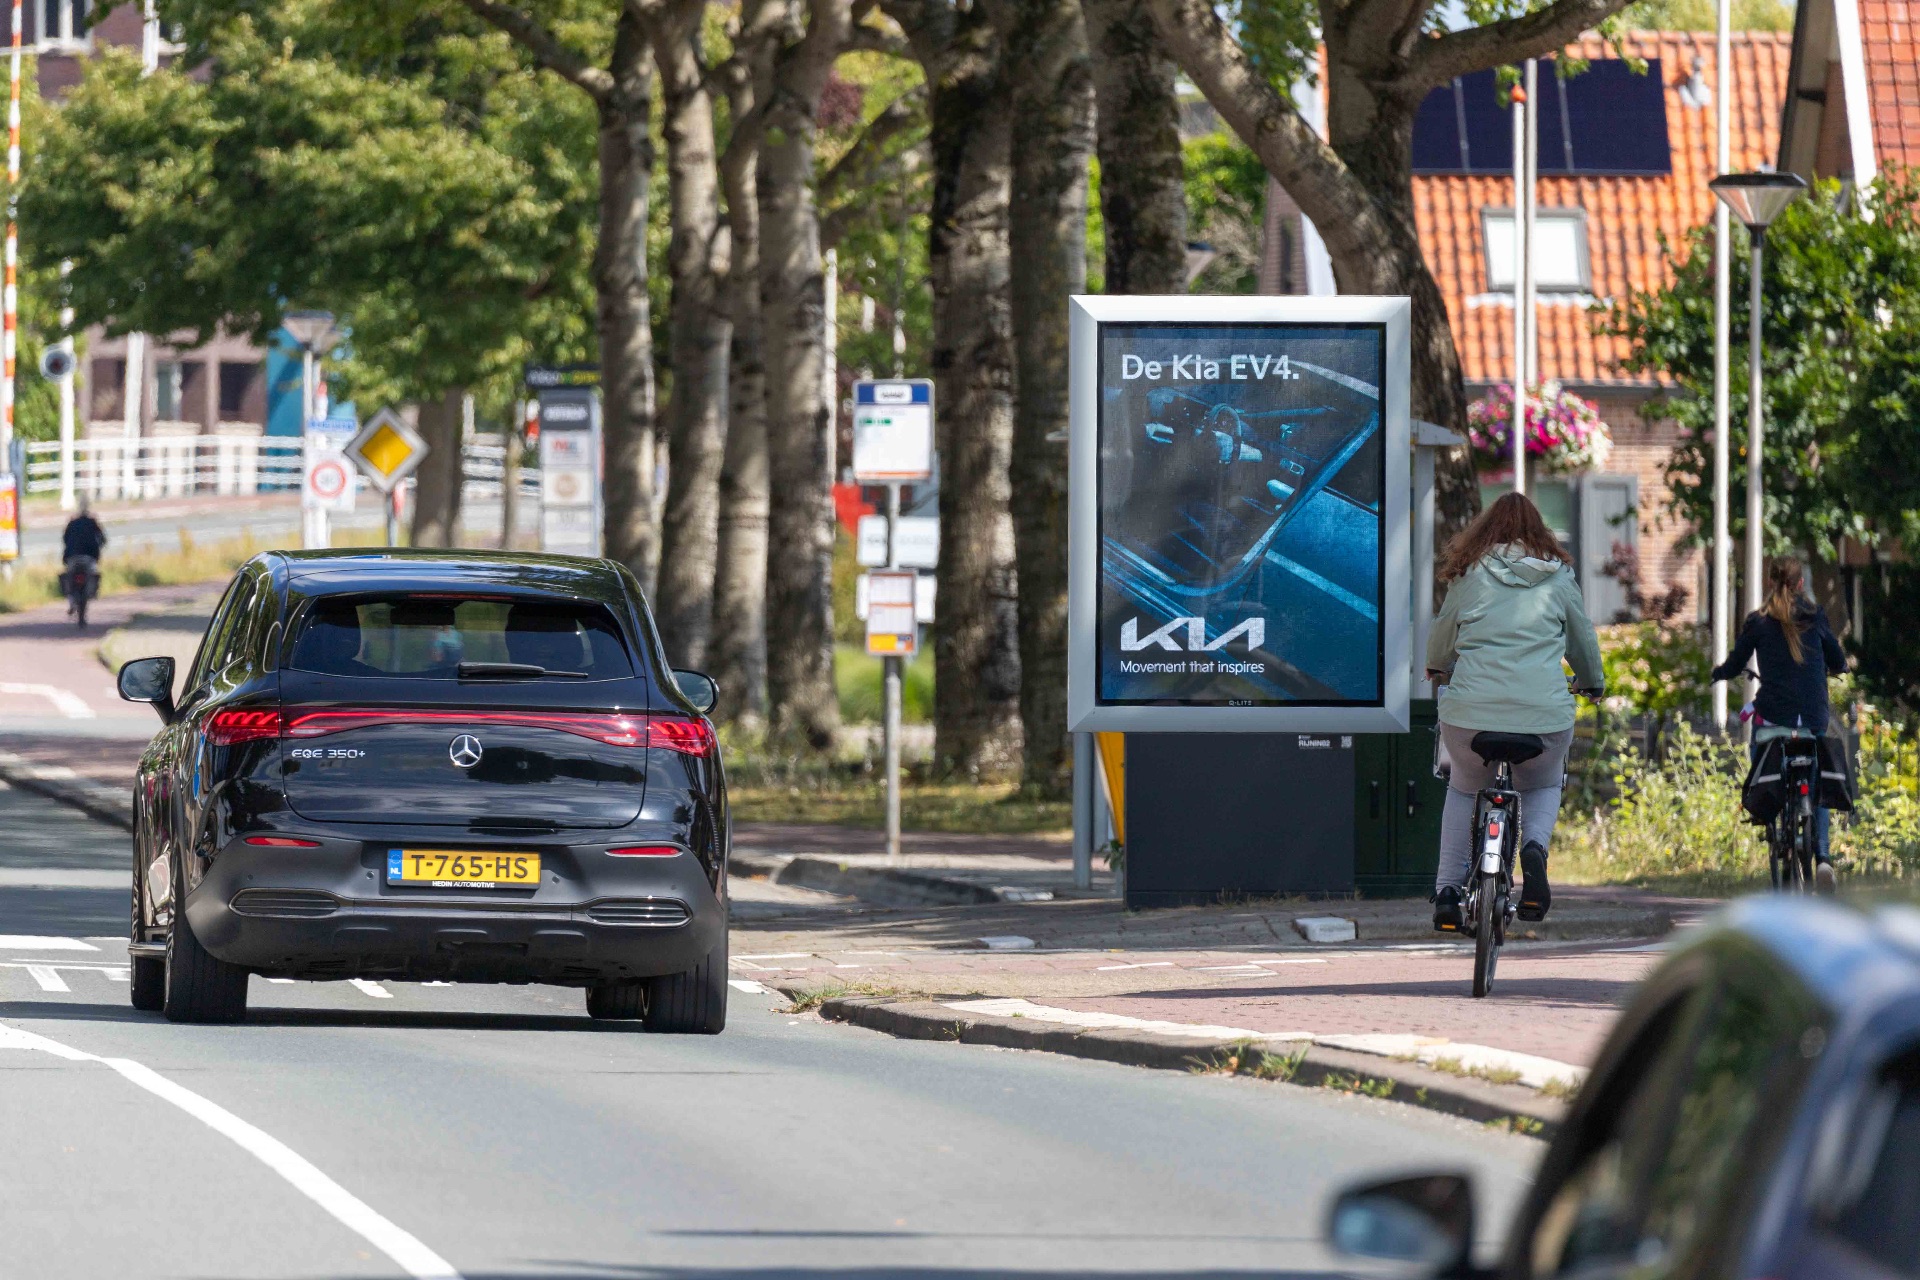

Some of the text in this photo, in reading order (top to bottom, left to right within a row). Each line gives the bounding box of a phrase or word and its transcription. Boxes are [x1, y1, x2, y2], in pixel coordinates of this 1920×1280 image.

[1122, 354, 1300, 380] De Kia EV4.
[1120, 616, 1266, 652] KIA
[1120, 660, 1265, 676] Movement that inspires
[291, 748, 366, 759] EQE 350+
[390, 867, 401, 875] NL
[410, 854, 529, 879] T-765-HS
